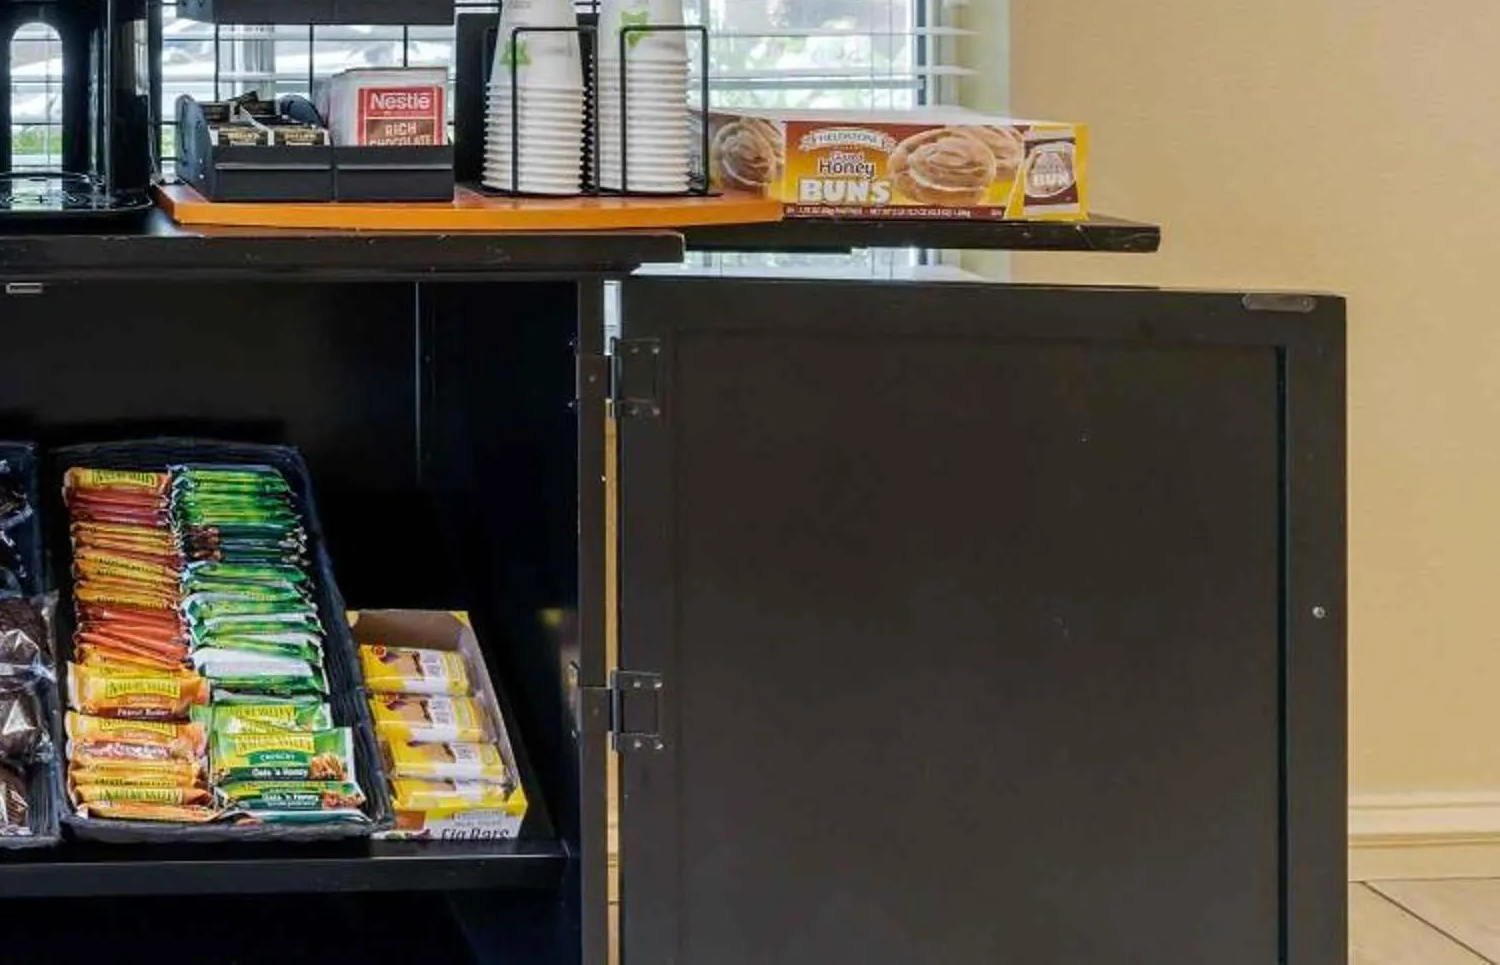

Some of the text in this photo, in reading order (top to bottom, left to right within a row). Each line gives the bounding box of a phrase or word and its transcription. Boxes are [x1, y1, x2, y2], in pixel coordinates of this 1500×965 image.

[385, 122, 417, 136] RICH
[818, 157, 876, 180] Honey
[799, 178, 892, 205] BUNS
